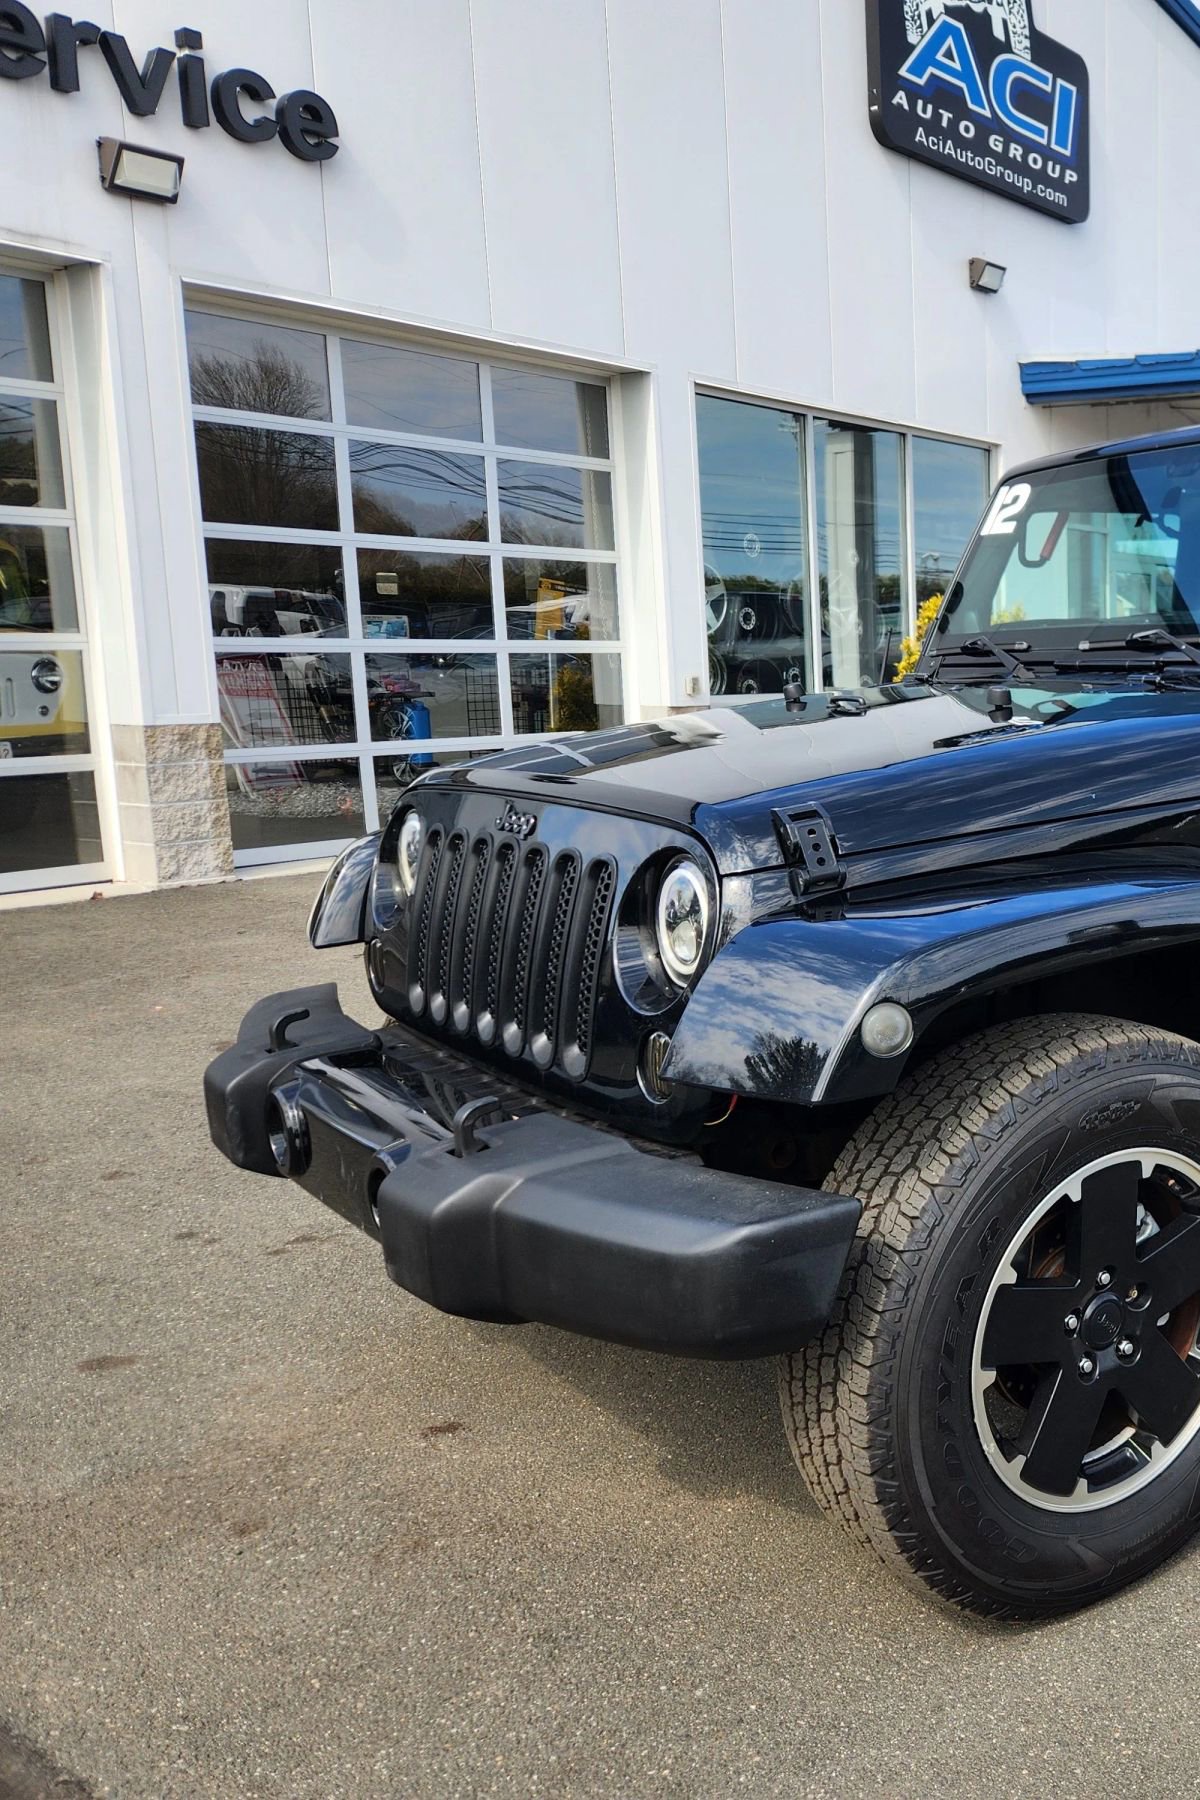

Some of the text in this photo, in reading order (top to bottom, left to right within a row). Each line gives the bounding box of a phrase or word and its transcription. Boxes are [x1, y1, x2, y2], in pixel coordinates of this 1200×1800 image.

[897, 12, 1077, 157] ACI
[891, 90, 1078, 184] AUTO GROUP
[914, 127, 1068, 207] AciAutoGroup.com
[980, 483, 1031, 536] 12
[494, 804, 537, 841] Jeep
[935, 1214, 1038, 1564] GOODYEAR
